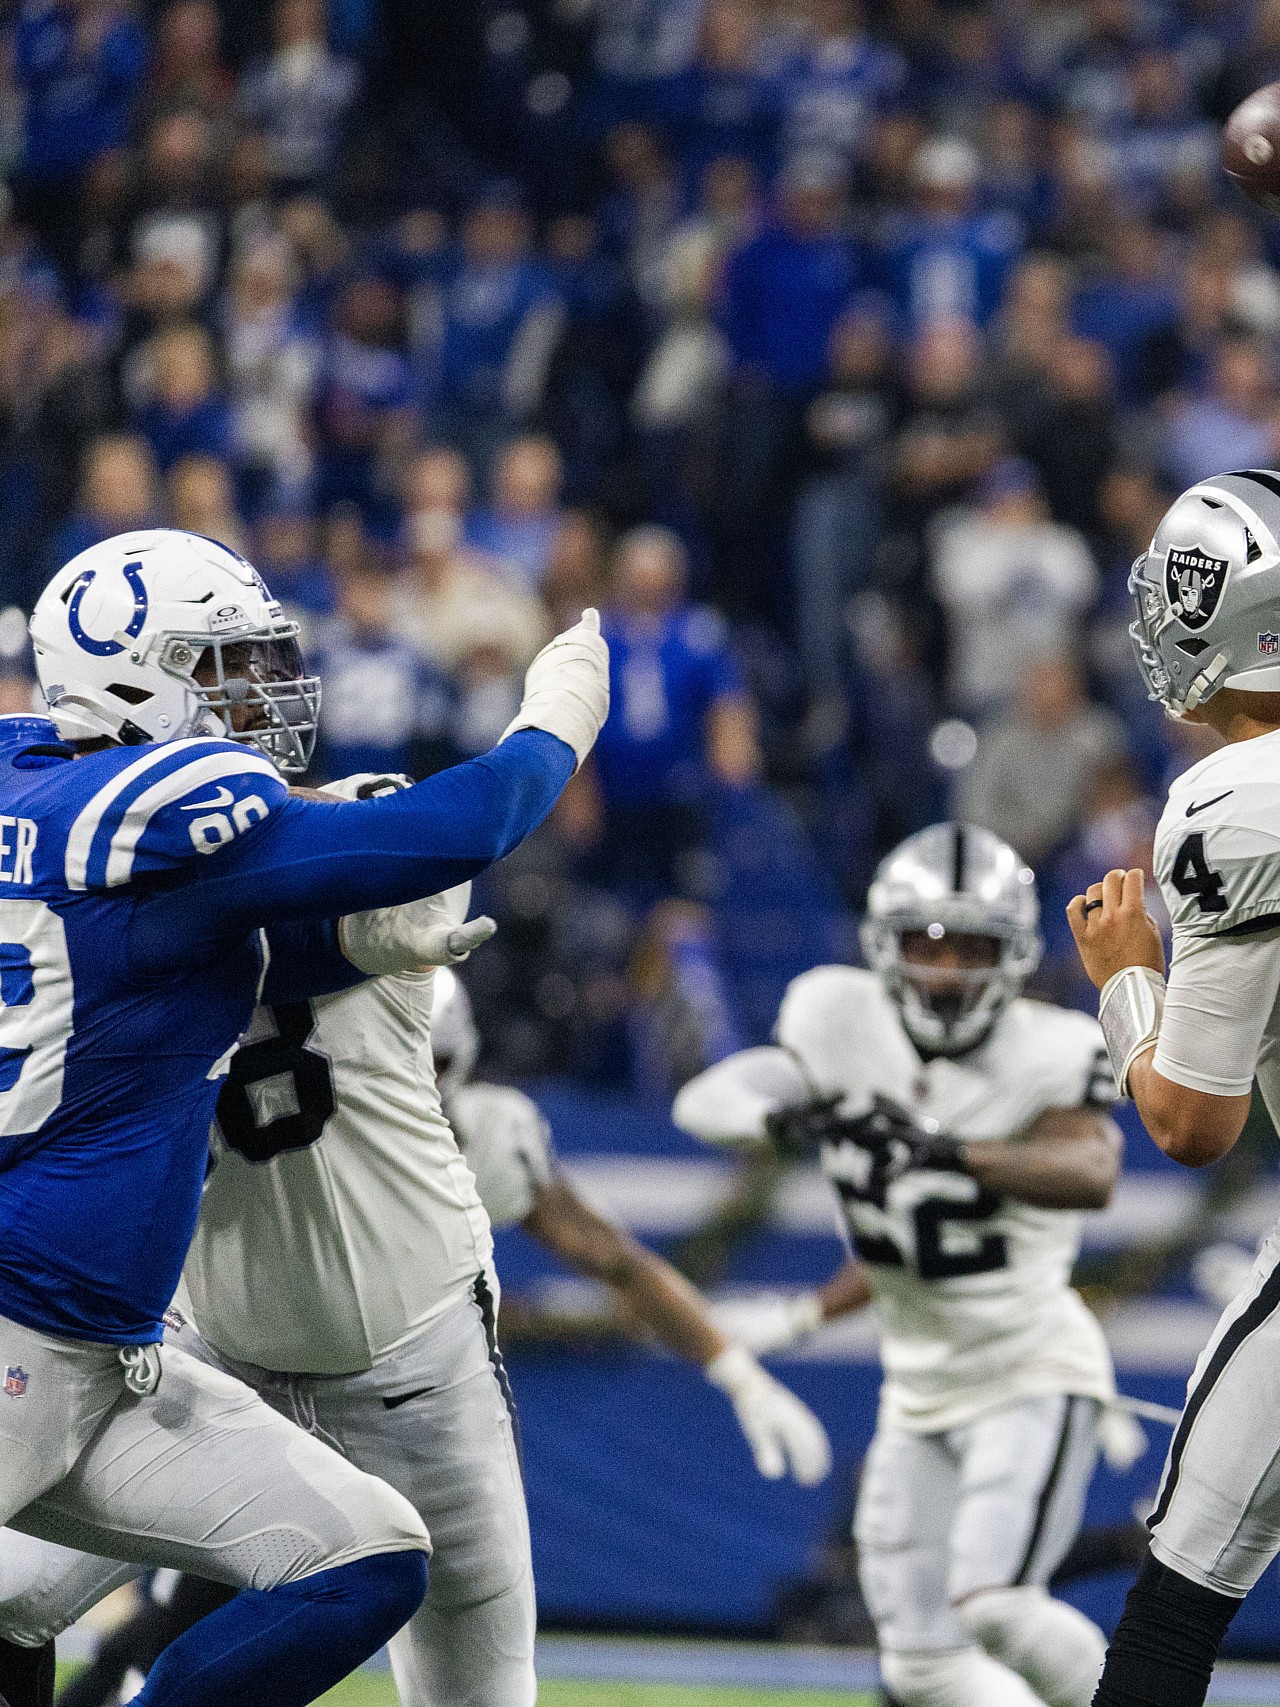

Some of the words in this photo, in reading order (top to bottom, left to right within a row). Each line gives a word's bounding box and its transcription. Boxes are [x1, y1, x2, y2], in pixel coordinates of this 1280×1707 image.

[1171, 552, 1222, 572] RAIDERS
[1260, 642, 1277, 653] NFL
[1171, 831, 1230, 913] 4
